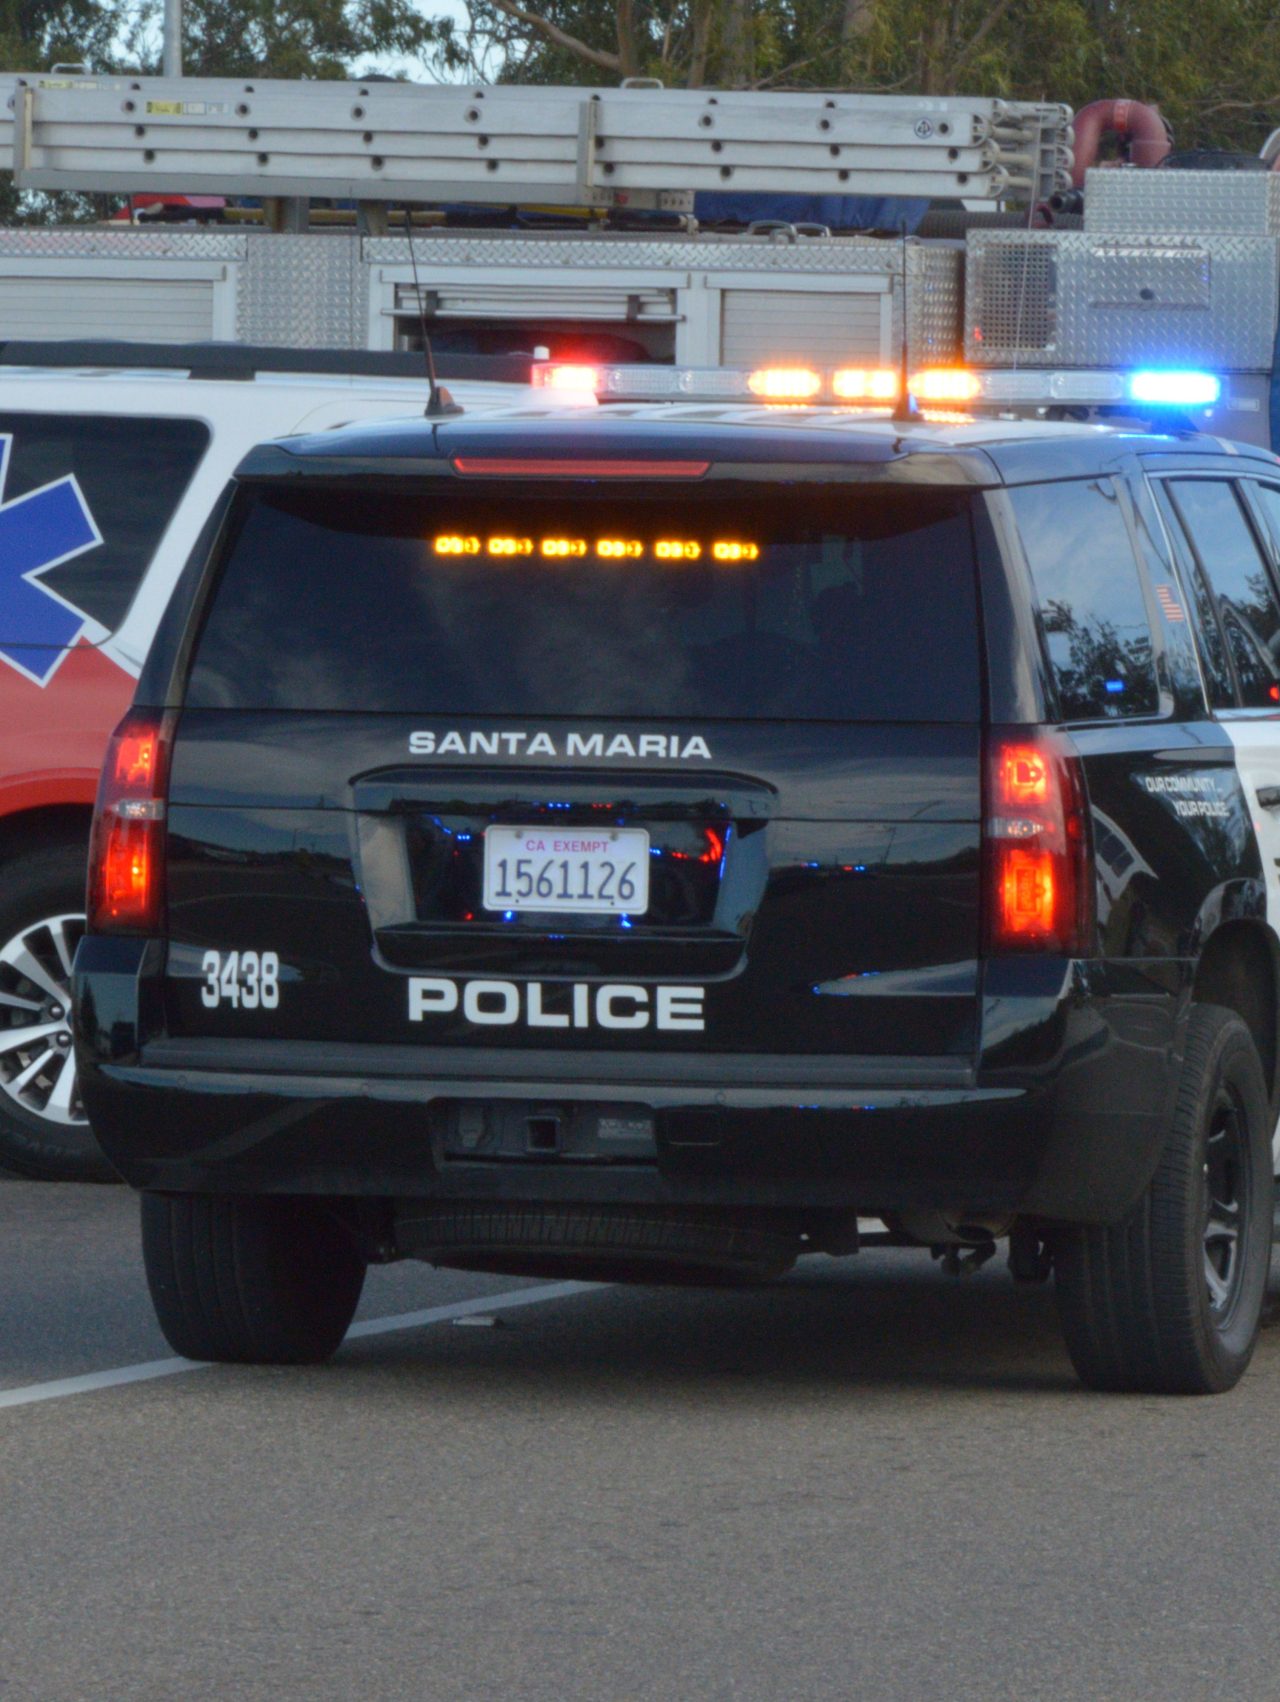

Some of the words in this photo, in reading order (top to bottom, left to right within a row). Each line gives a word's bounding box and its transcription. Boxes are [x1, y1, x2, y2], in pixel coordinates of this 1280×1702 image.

[408, 731, 557, 756] SANTA
[566, 732, 712, 759] MARIA
[1144, 776, 1167, 793] OUR
[1172, 801, 1201, 817] YOUR
[525, 839, 545, 851] CA
[553, 840, 609, 853] EXEMPT
[495, 858, 636, 901] 1561126
[200, 949, 280, 1010] 3438
[408, 976, 706, 1031] POLICE
